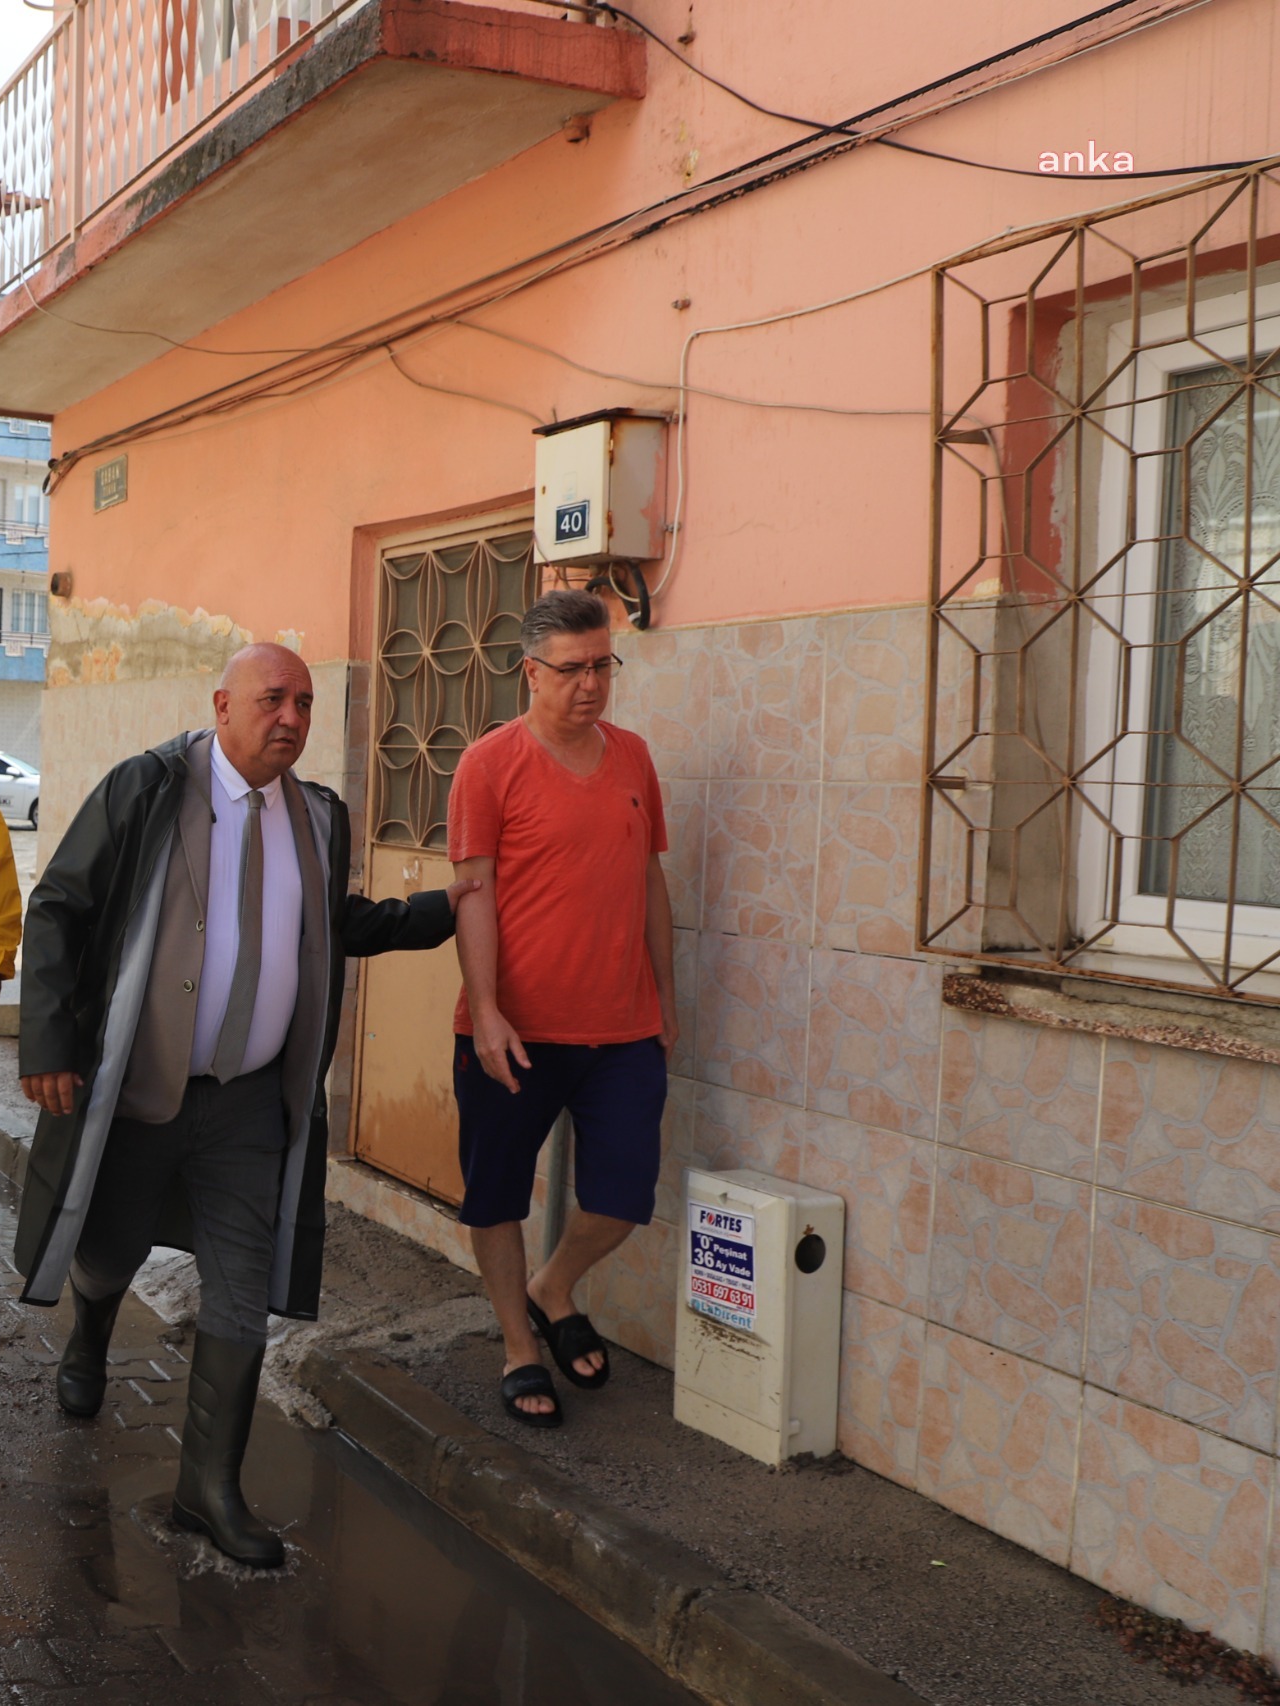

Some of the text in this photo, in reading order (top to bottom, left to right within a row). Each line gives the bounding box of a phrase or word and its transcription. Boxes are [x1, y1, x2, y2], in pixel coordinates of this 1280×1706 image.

[560, 511, 582, 533] 40
[700, 1210, 742, 1233] FORTES
[694, 1248, 751, 1278] 36 Ay Vade
[713, 1244, 747, 1261] Peşinat
[692, 1278, 712, 1295] 0531
[713, 1285, 729, 1300] 697
[729, 1290, 741, 1304] 63
[742, 1294, 753, 1308] 91
